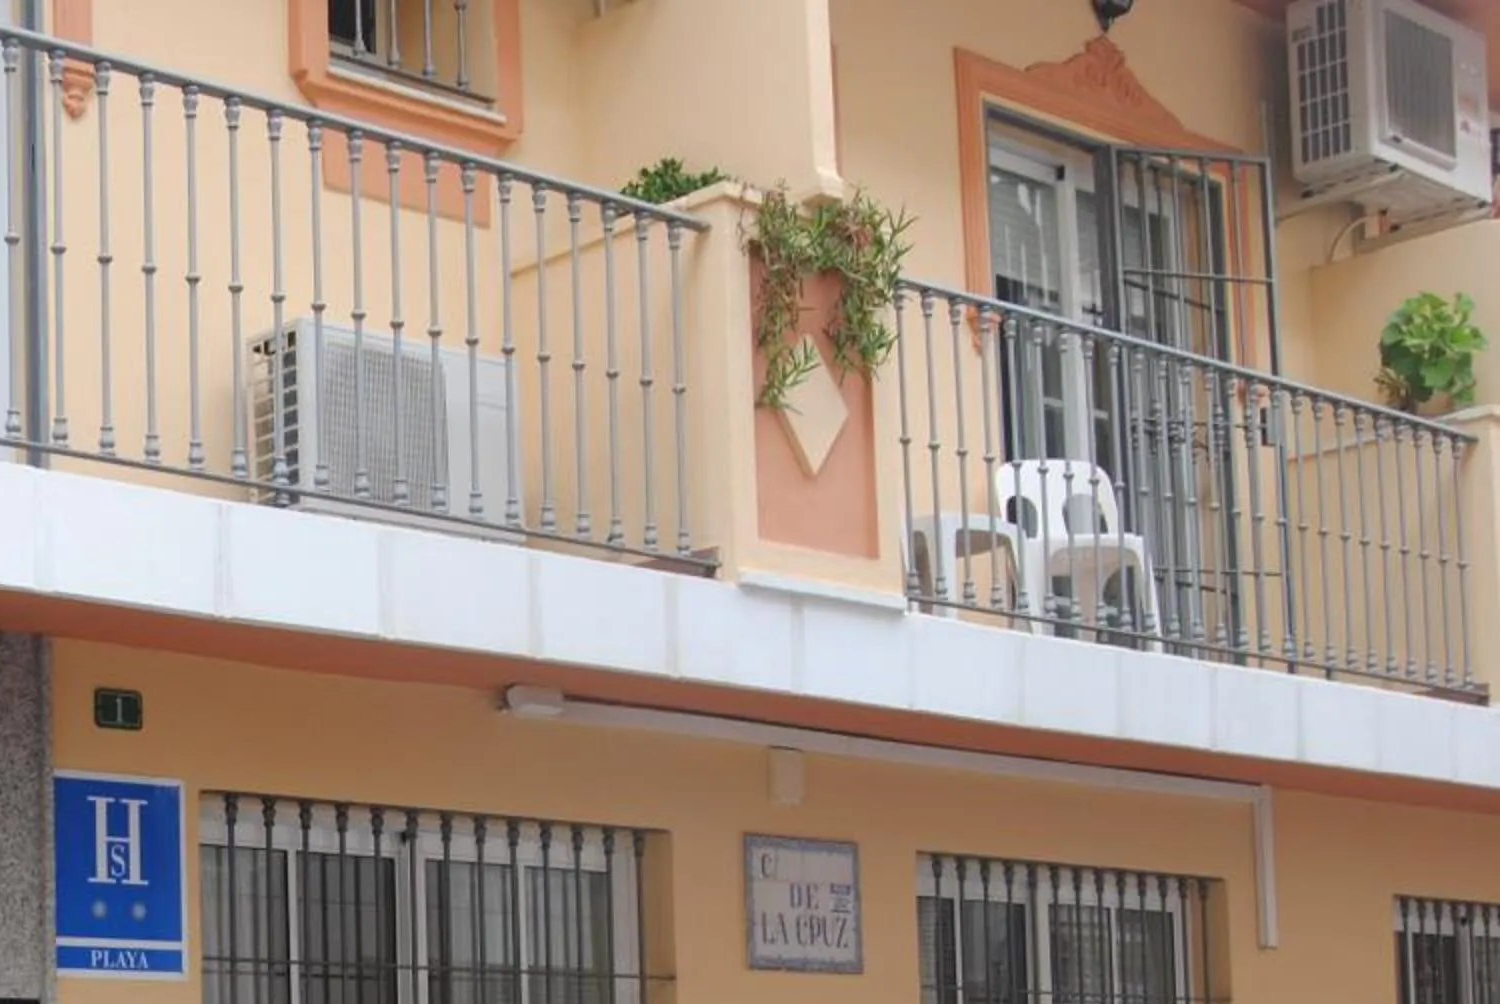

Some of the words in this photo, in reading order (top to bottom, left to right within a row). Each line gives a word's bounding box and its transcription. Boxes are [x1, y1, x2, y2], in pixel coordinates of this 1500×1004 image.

[761, 910, 790, 946] LA
[795, 914, 850, 949] CRUZ
[90, 949, 149, 970] PLAYA
